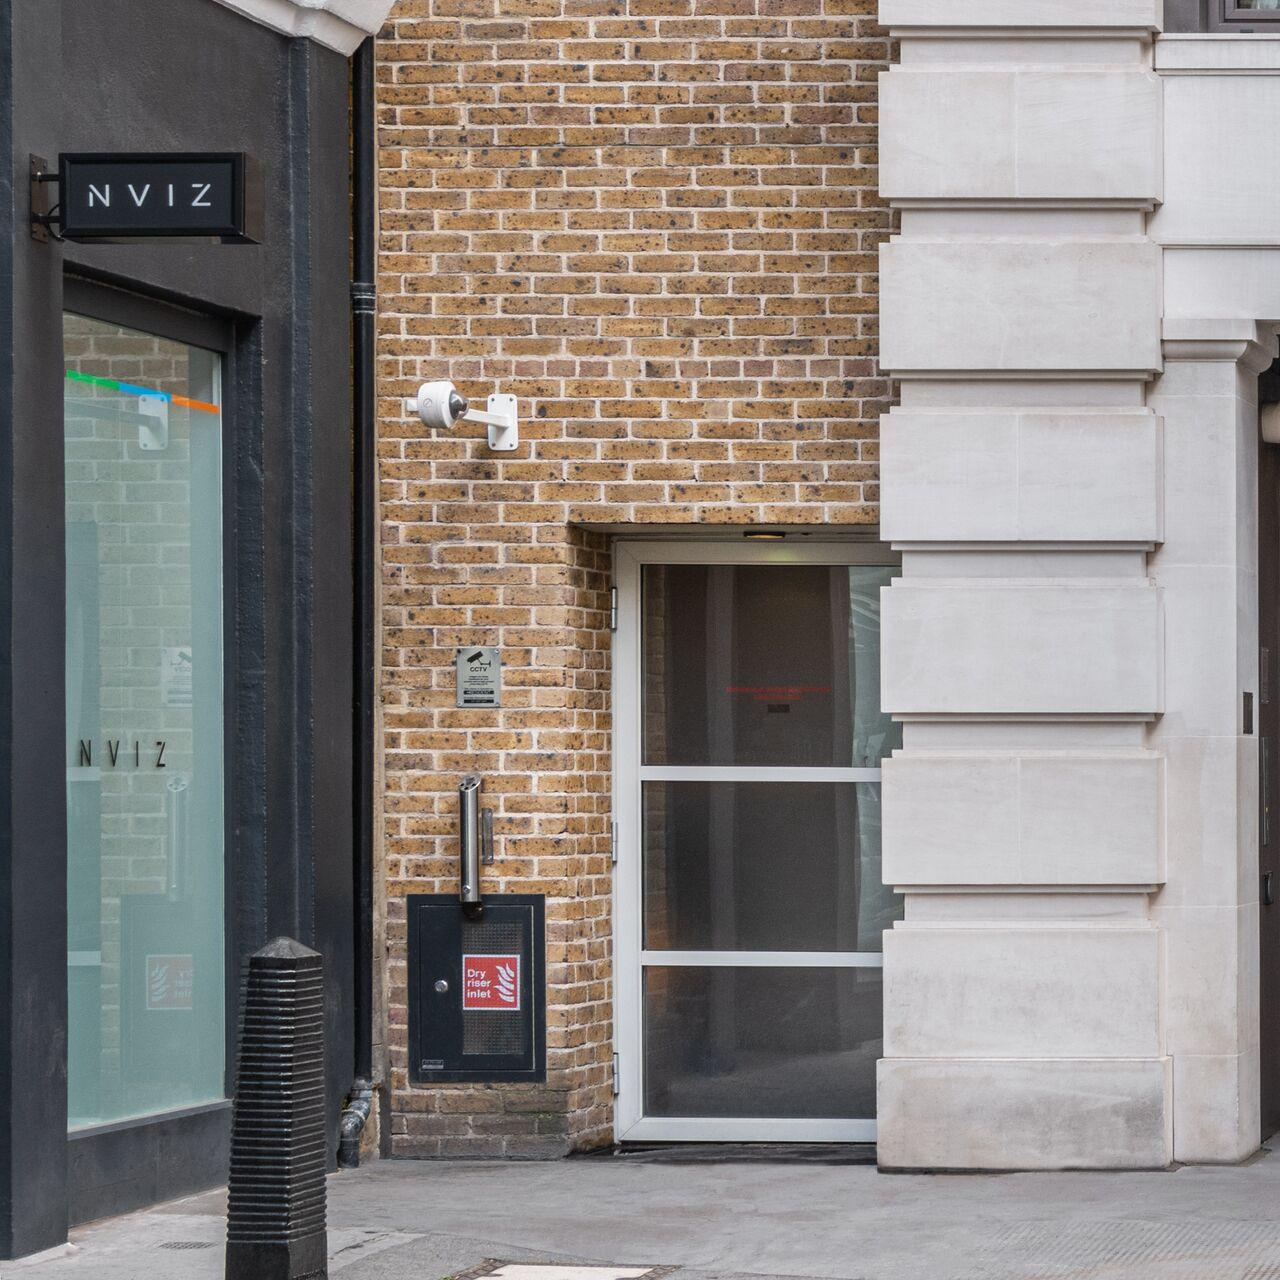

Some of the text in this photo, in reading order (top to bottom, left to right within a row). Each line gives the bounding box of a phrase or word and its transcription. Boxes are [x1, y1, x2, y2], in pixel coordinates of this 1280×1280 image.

[88, 183, 212, 207] NVIZ
[79, 738, 167, 768] NVIZ
[467, 968, 486, 979] Dry
[467, 978, 492, 987] riser
[467, 989, 492, 998] inlet
